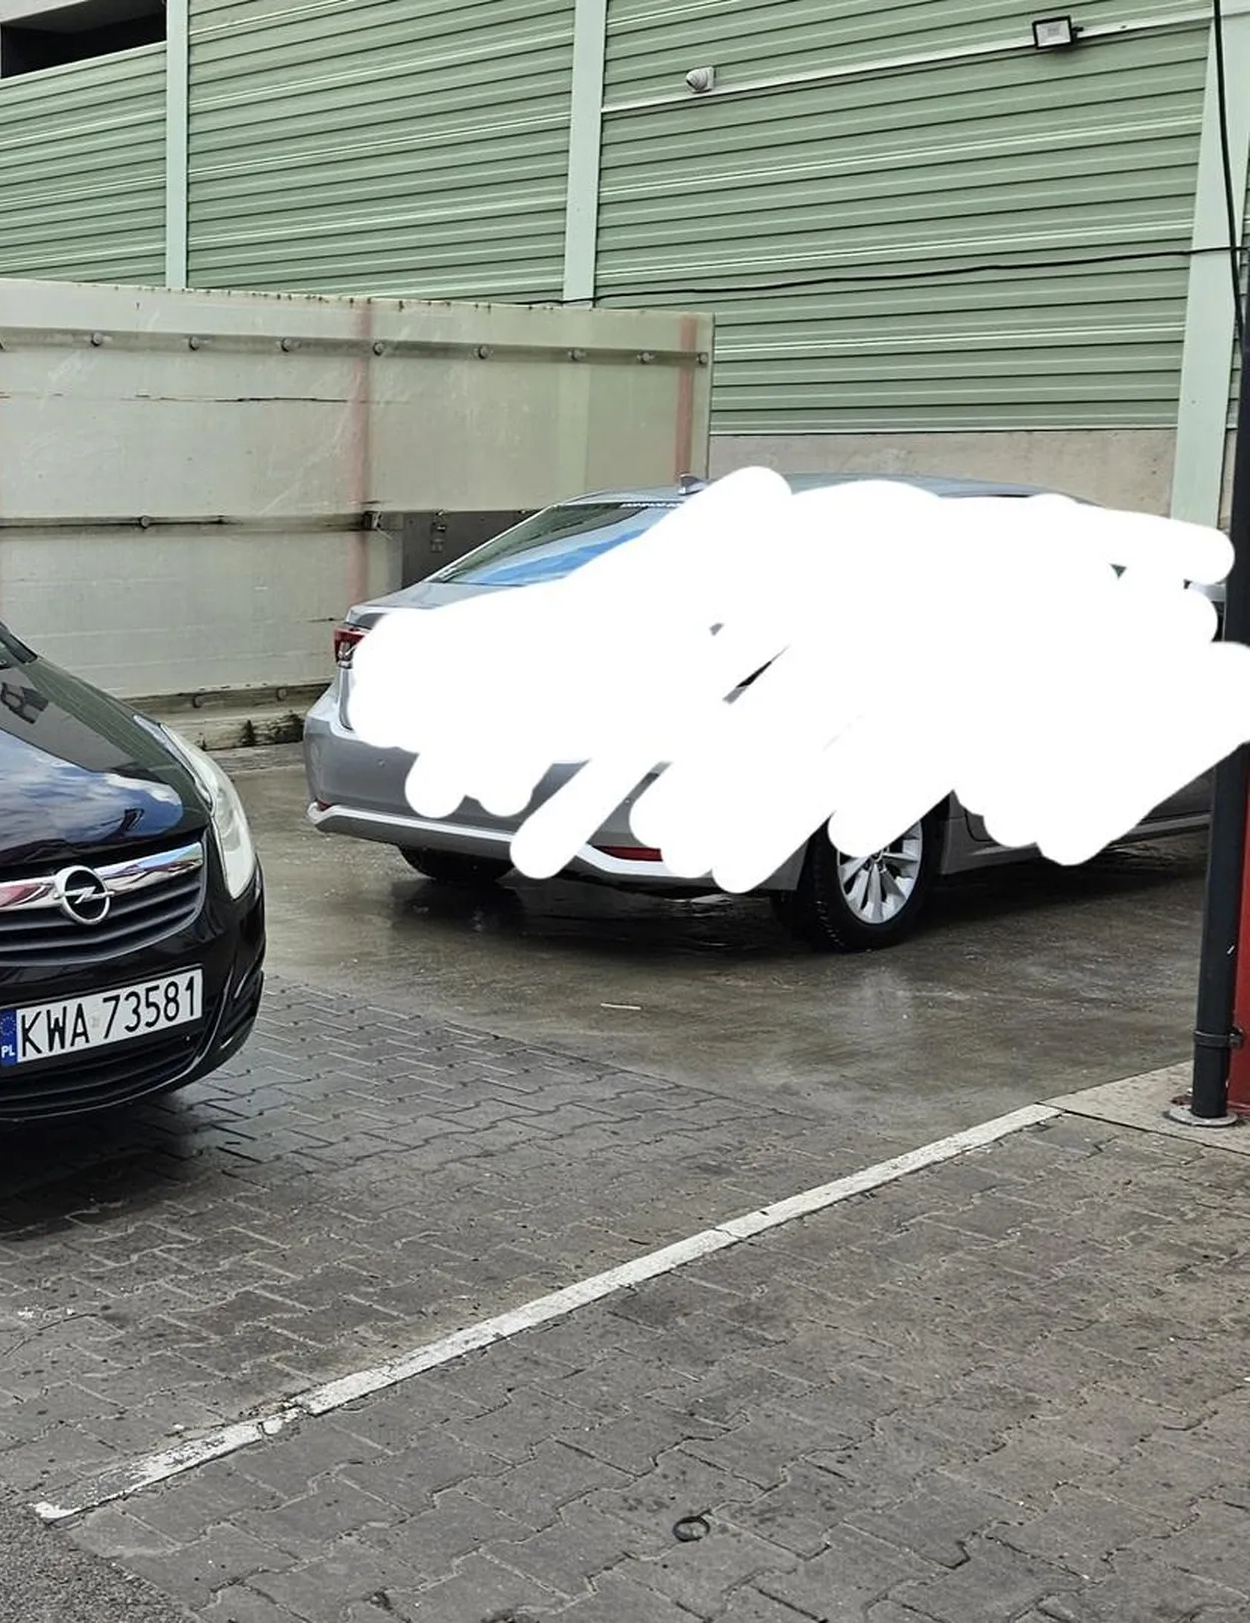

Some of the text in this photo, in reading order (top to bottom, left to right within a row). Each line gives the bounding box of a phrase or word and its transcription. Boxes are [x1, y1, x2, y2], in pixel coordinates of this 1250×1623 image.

[21, 976, 195, 1058] KWA 73581
[1, 1045, 16, 1058] PL
